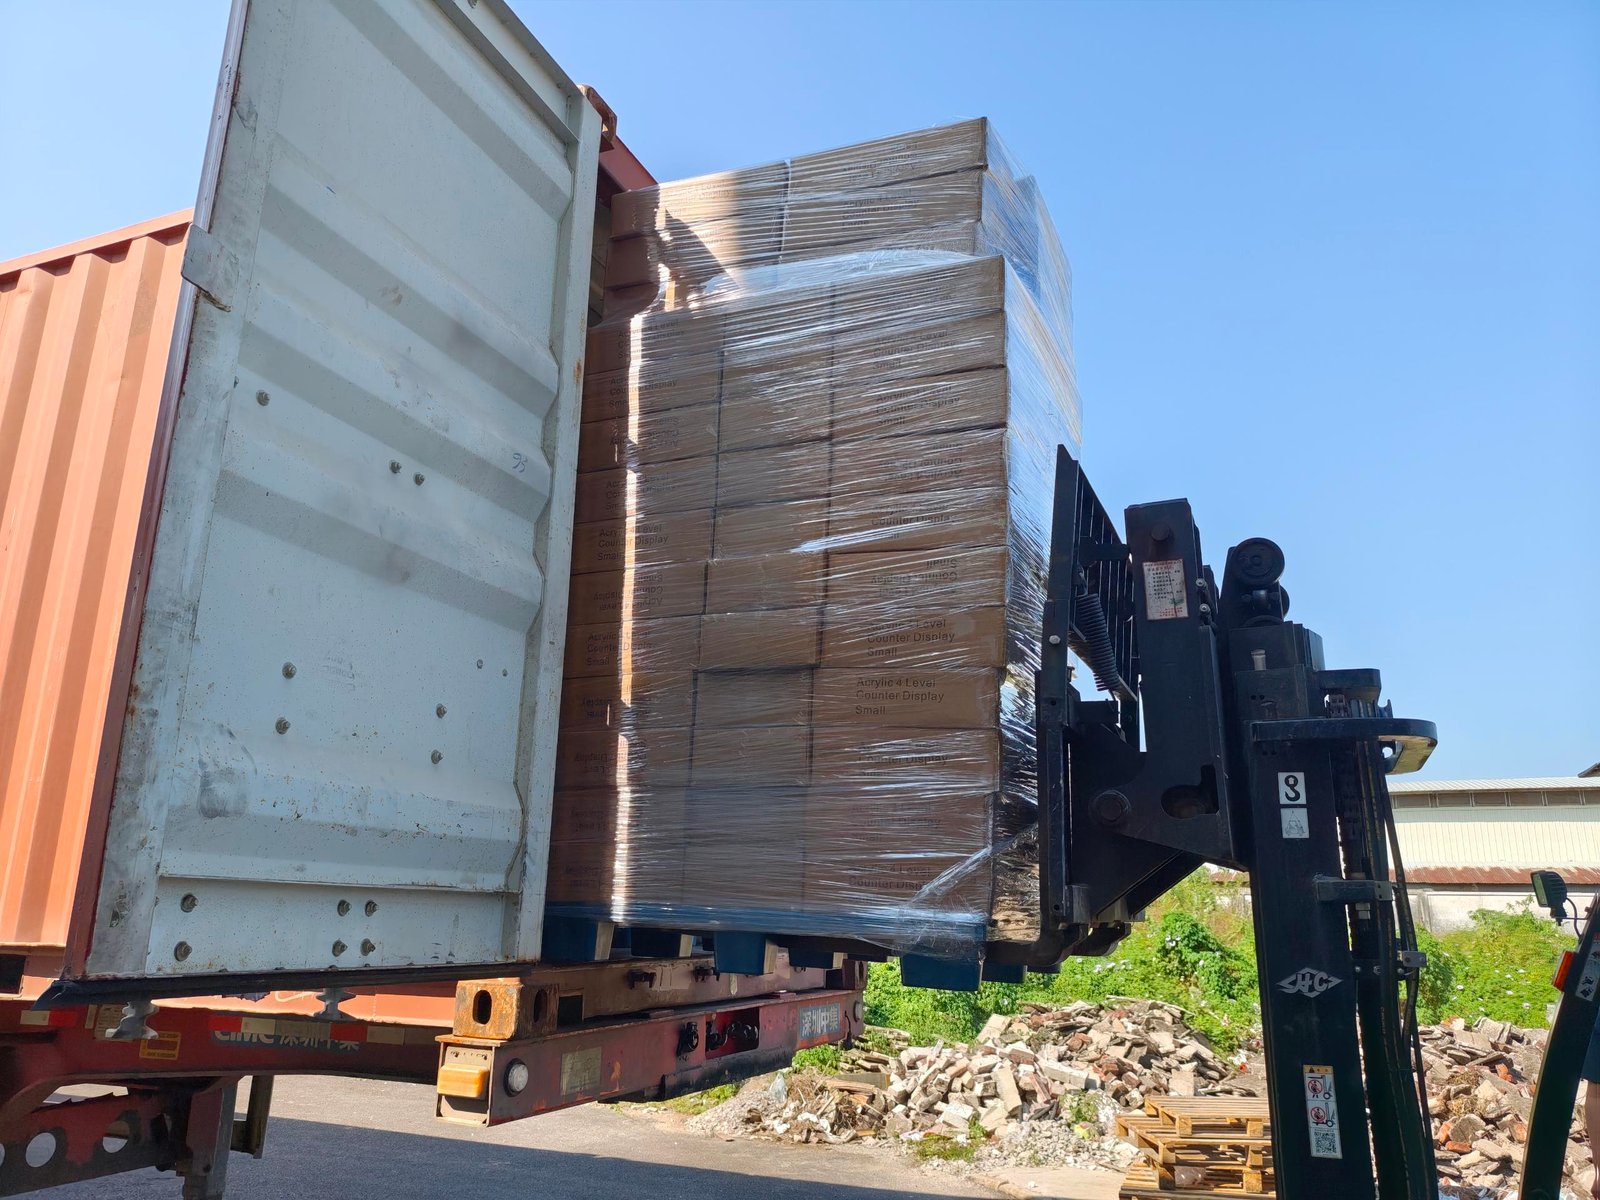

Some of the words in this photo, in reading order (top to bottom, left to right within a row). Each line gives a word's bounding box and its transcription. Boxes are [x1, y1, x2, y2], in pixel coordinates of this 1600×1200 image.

[867, 633, 910, 643] Counter
[913, 631, 955, 643] Display
[867, 646, 897, 657] Small
[857, 677, 893, 689] Acrylic
[896, 678, 902, 686] 4
[905, 678, 936, 688] Level
[856, 690, 900, 700] Counter
[902, 690, 944, 703] Display
[855, 705, 886, 715] Small
[801, 1006, 838, 1053] 深圳中集
